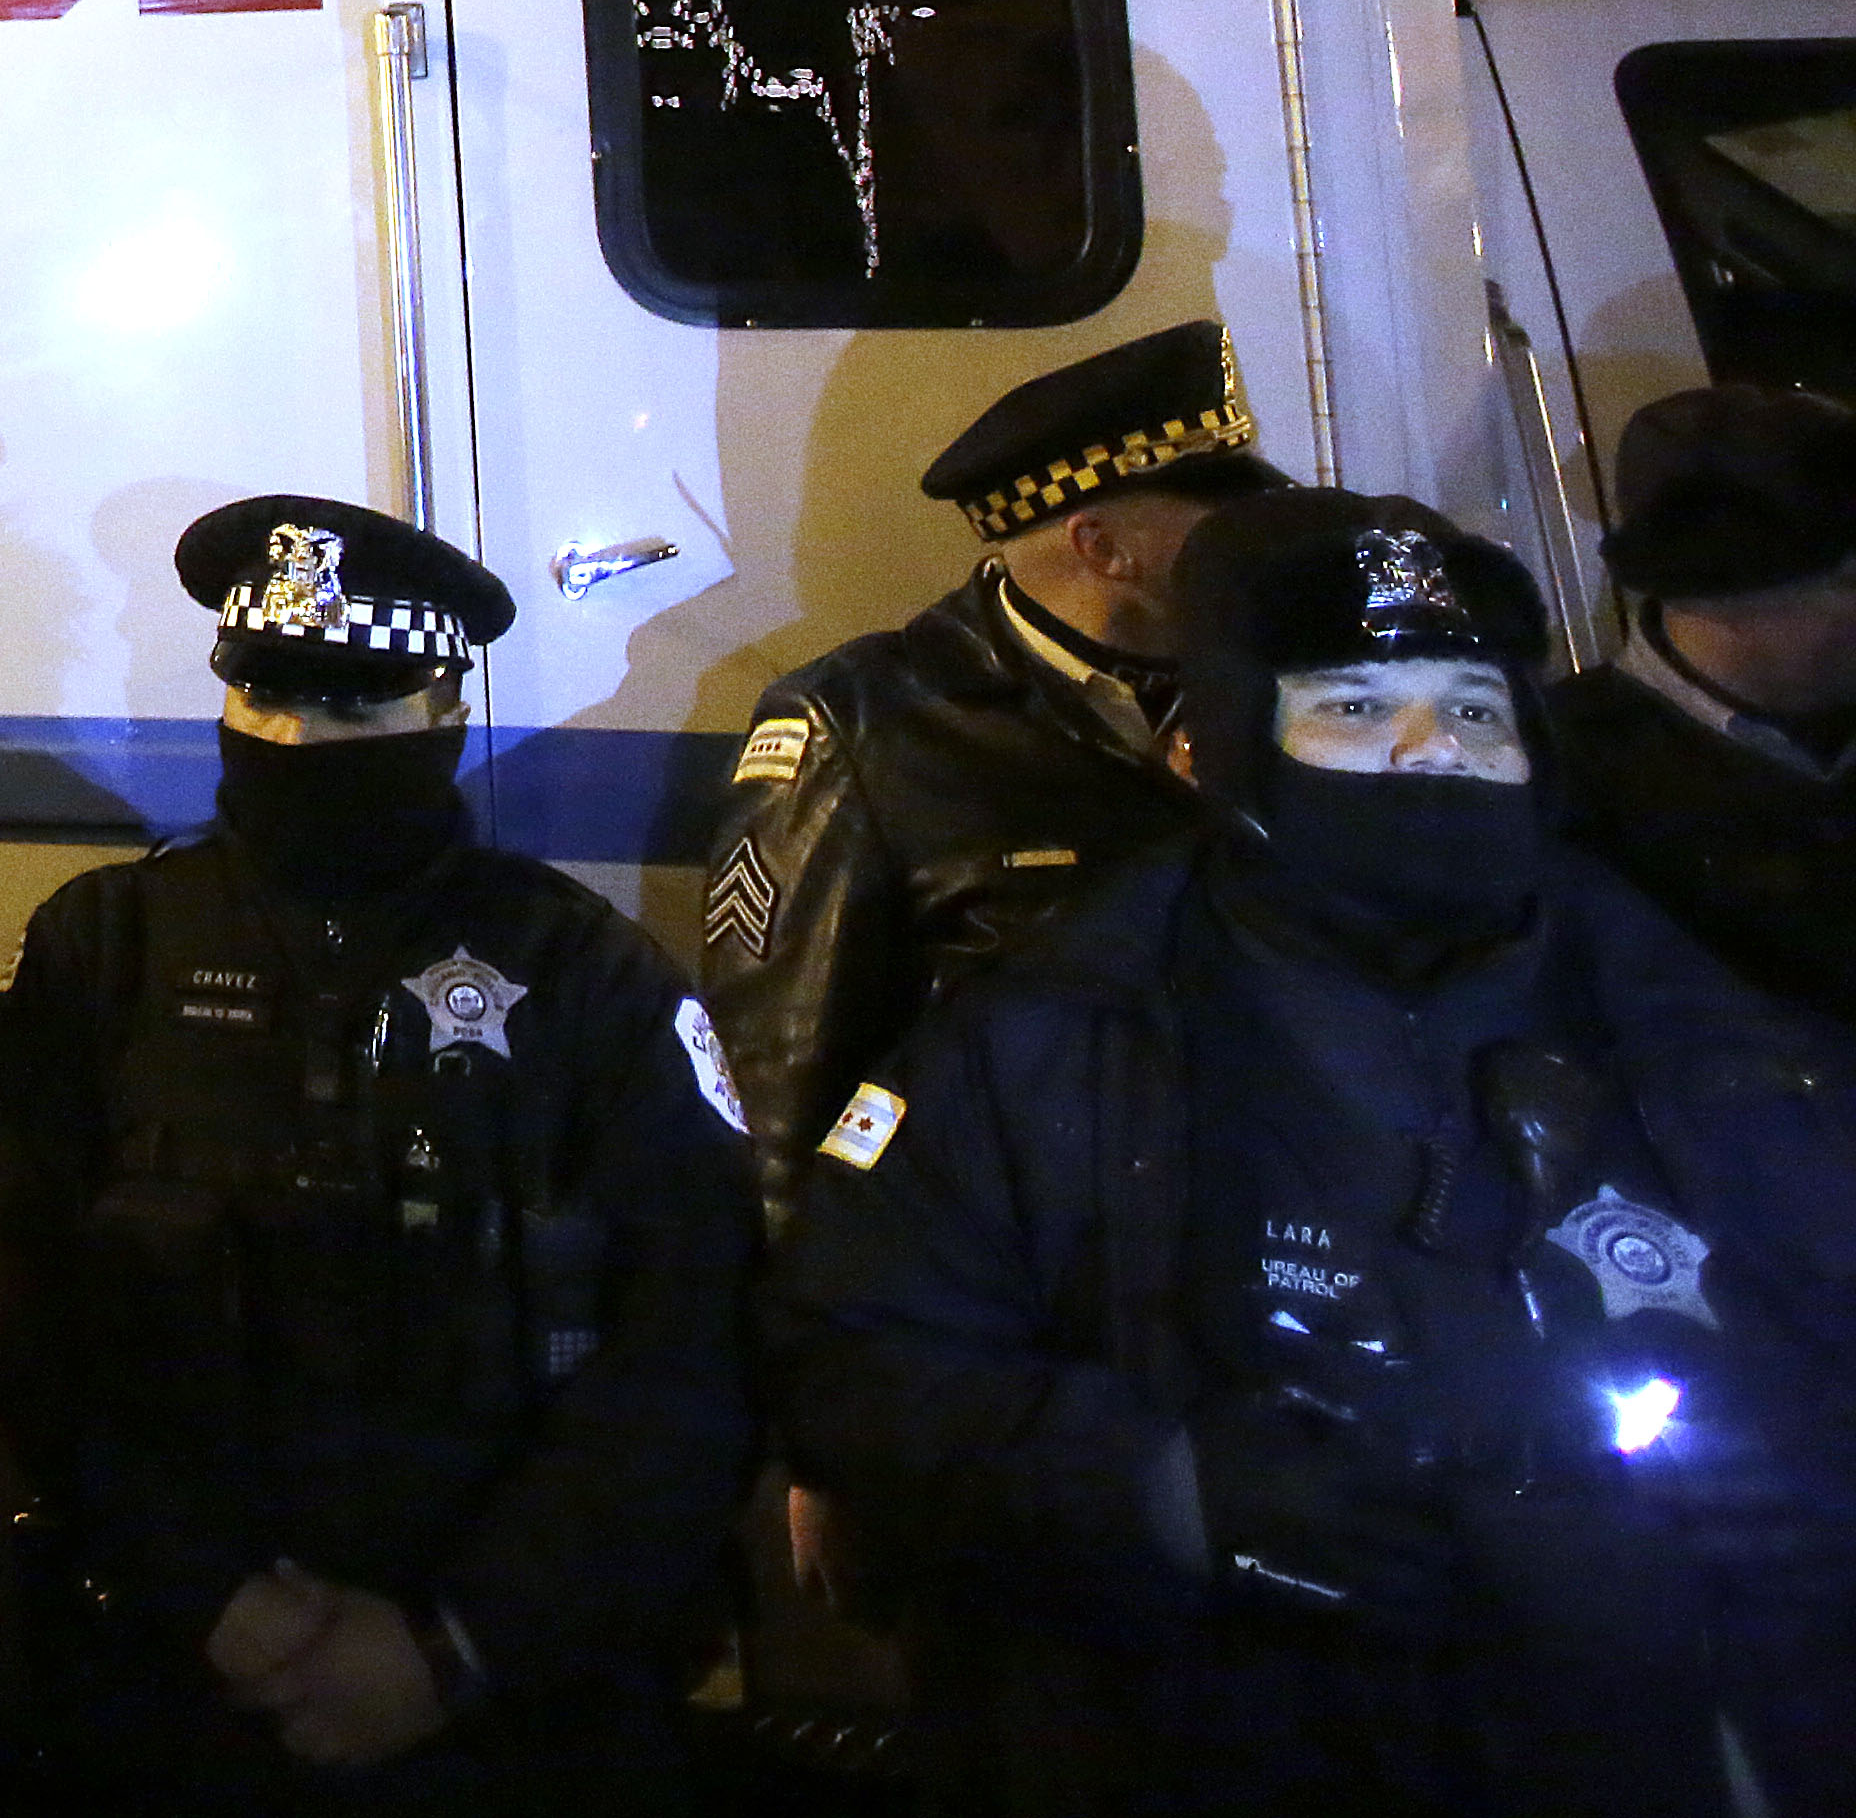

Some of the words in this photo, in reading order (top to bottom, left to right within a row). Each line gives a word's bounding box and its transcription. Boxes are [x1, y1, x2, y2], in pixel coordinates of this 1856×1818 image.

[1266, 1220, 1331, 1249] LARA
[1261, 1258, 1326, 1282] UREAU
[1333, 1272, 1361, 1289] OF
[1268, 1273, 1342, 1300] PATROL
